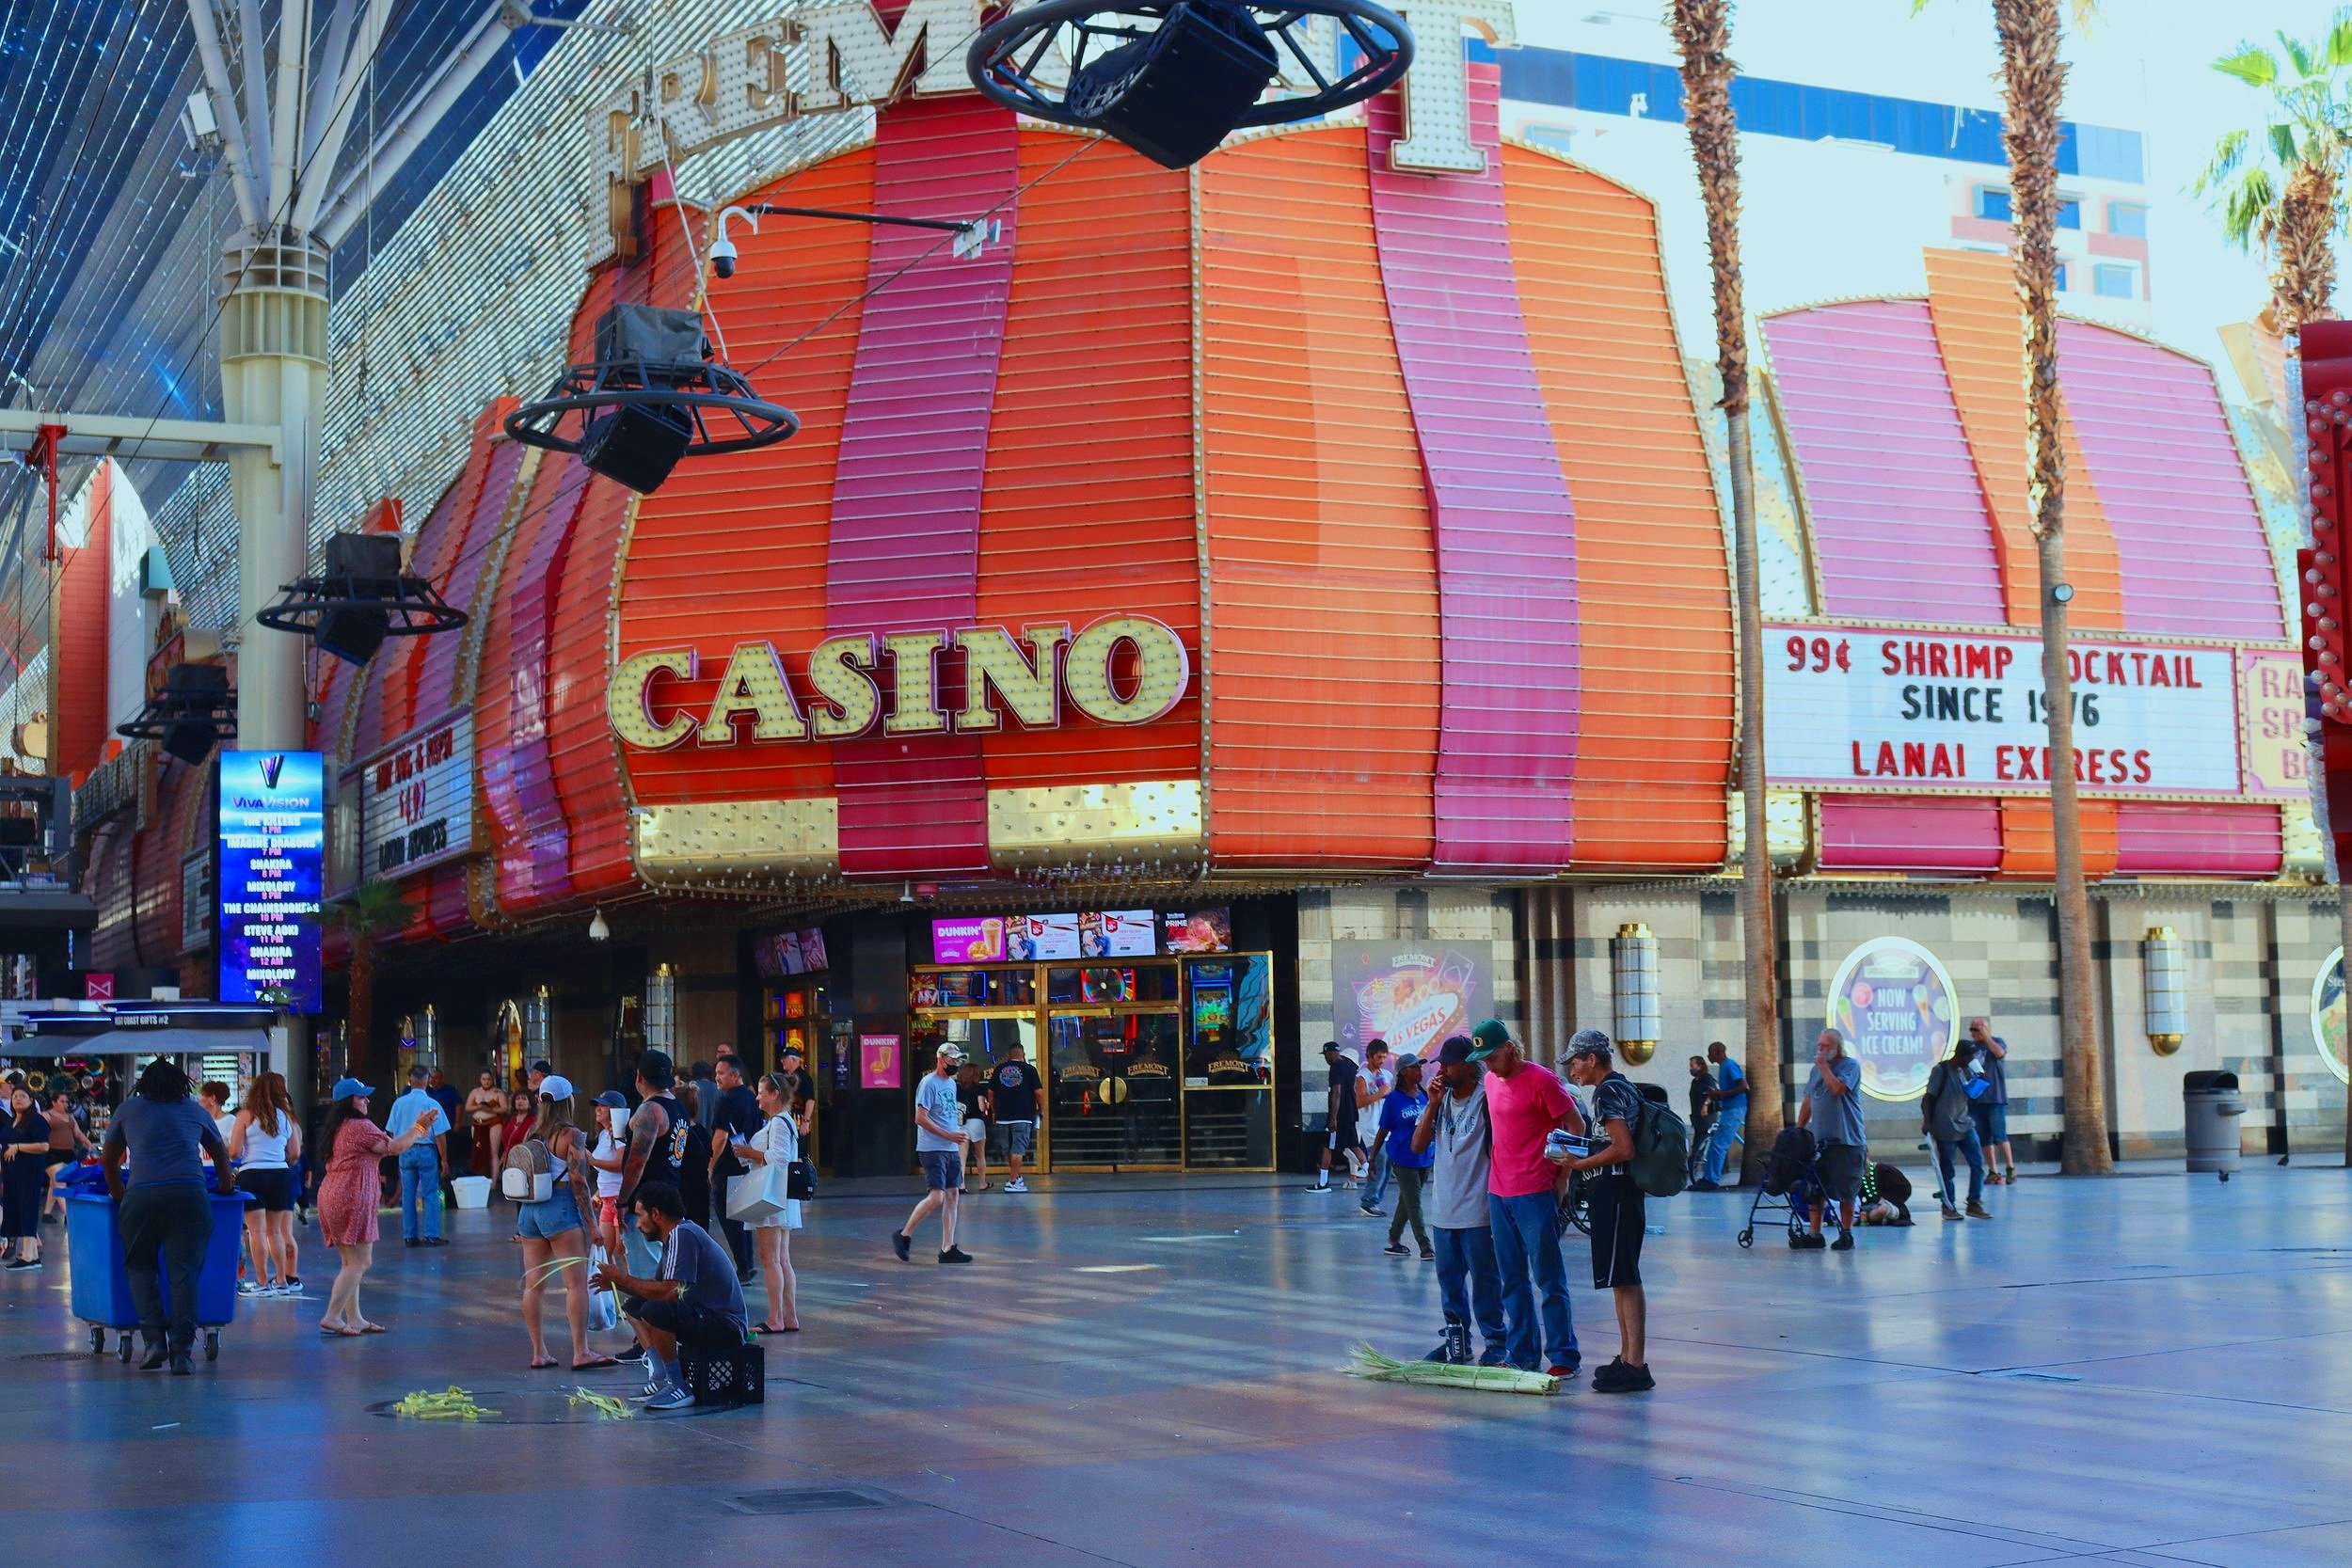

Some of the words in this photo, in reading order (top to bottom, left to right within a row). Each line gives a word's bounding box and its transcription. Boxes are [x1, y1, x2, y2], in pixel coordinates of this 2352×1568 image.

[1787, 636, 1851, 673] 99¢
[1882, 639, 2013, 680] SHRIMP
[2042, 648, 2202, 689] OCKTAIL
[607, 612, 1189, 752] CASINO
[1901, 684, 2004, 723] SINCE
[1851, 740, 1966, 778] LANAI
[268, 826, 282, 834] PM
[268, 847, 282, 856] PM
[249, 859, 293, 870] SHAKIRA
[268, 869, 282, 879] PM
[246, 880, 296, 892] MIXOLOGY
[268, 892, 282, 900] PM
[223, 902, 242, 913] THE
[270, 913, 284, 922] PM
[1166, 919, 1188, 927] PRIME
[244, 925, 273, 936] STEVE
[274, 925, 299, 936] AOKI
[937, 926, 981, 938] DUNKIN'
[270, 935, 284, 943] PM
[249, 946, 293, 958] SHAKIRA
[260, 958, 269, 966] 12
[270, 958, 284, 966] AM
[246, 969, 296, 980] MIXOLOGY
[1877, 988, 1907, 1008] NOW
[1406, 1006, 1446, 1039] VEGAS
[1867, 1011, 1917, 1032] SERVING
[863, 1037, 898, 1046] DUNKIN'
[1861, 1036, 1880, 1054] ICE
[1882, 1036, 1924, 1054] CREAM!
[1127, 1062, 1169, 1076] FREMONT
[1208, 1059, 1251, 1073] FREMONT
